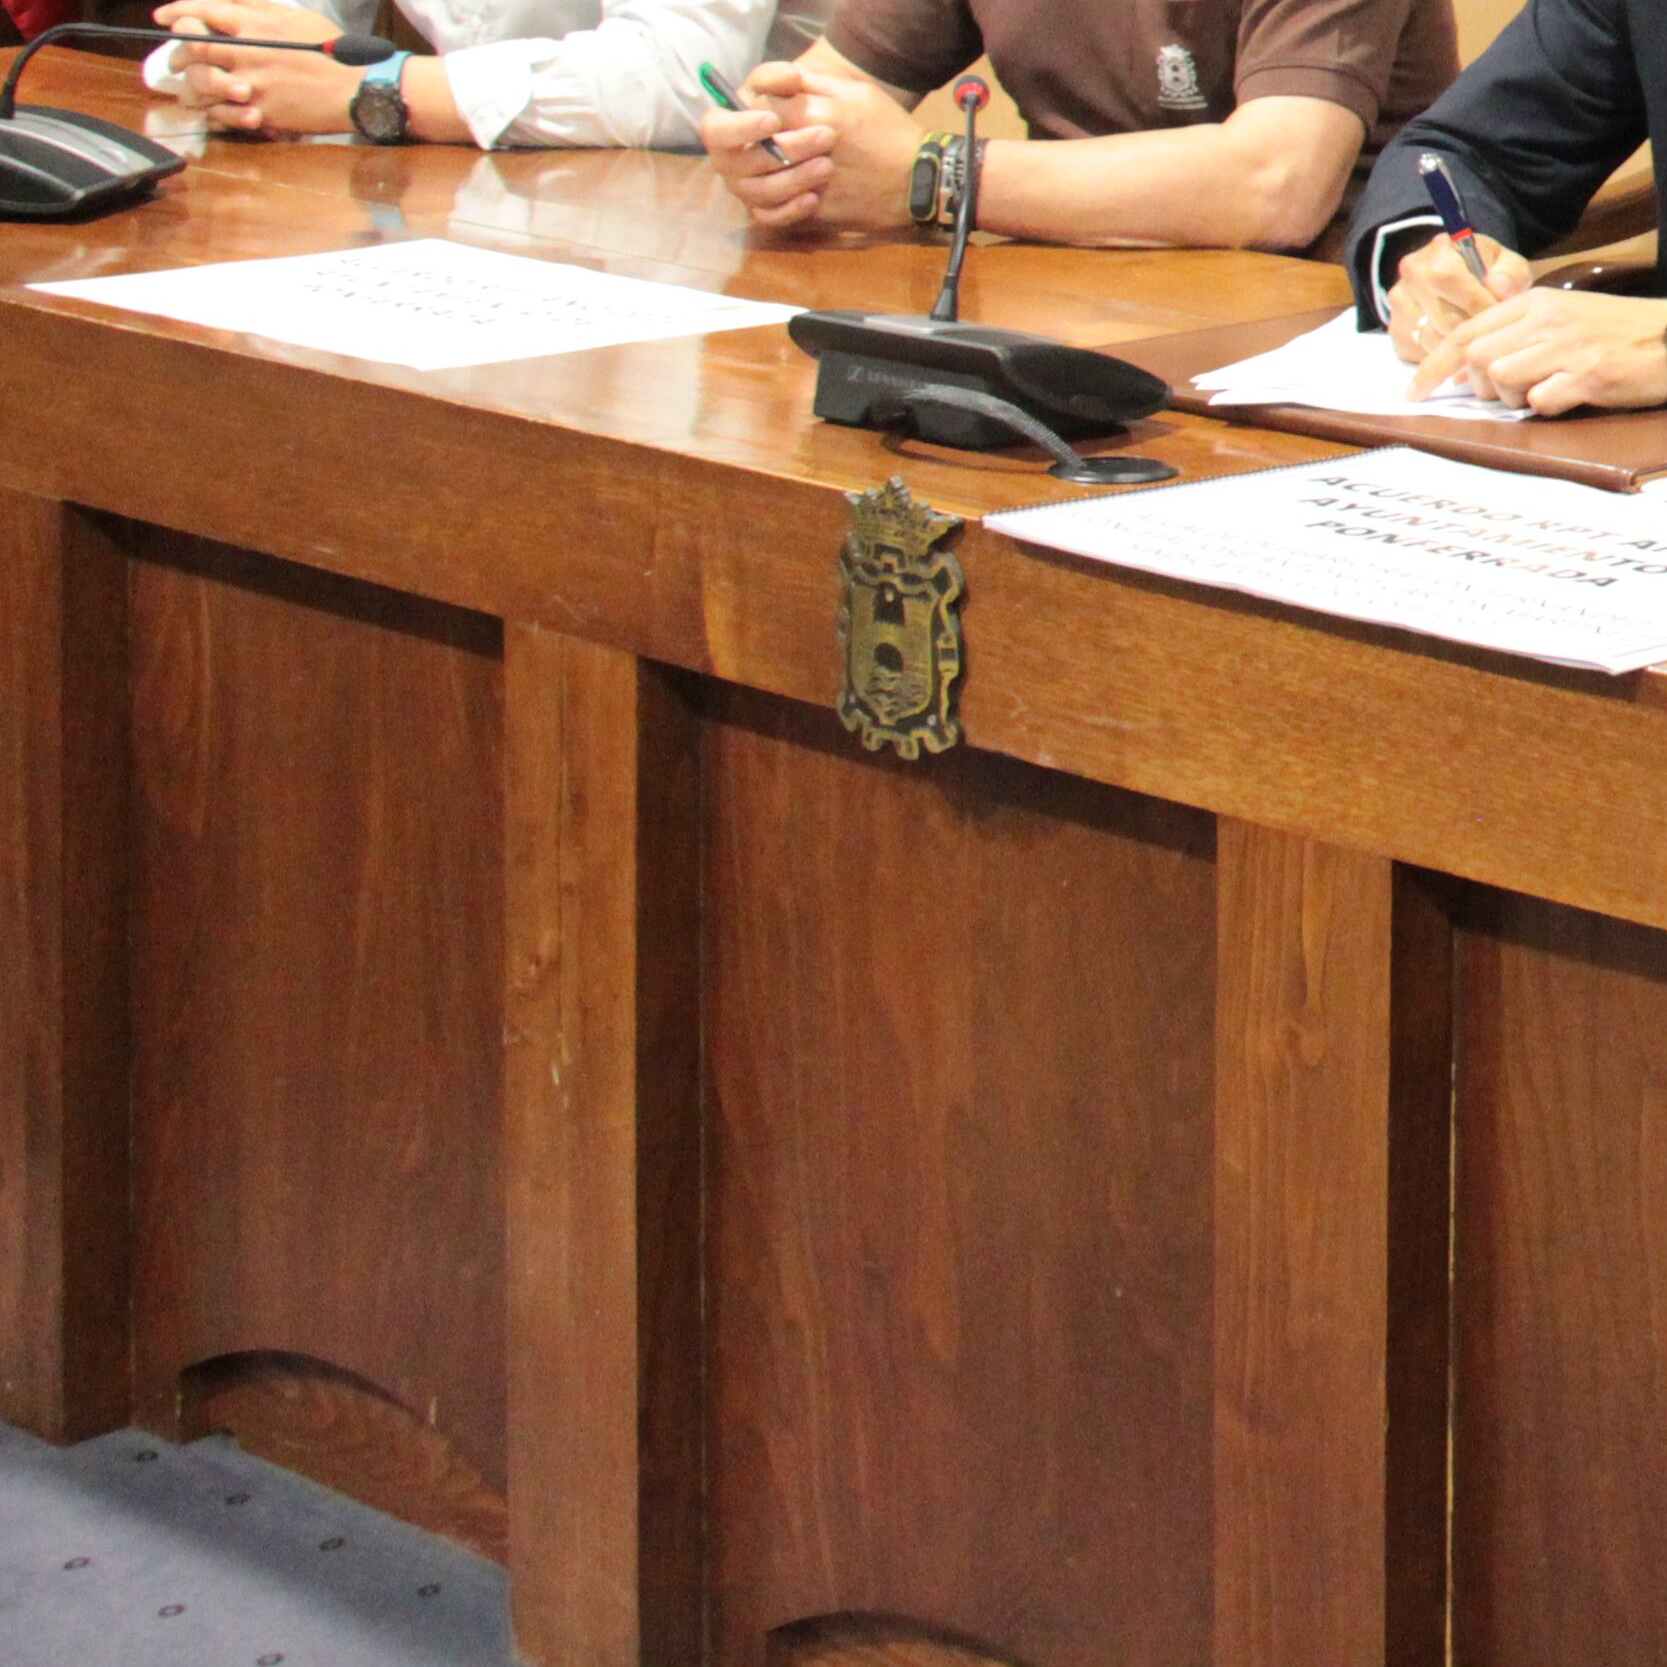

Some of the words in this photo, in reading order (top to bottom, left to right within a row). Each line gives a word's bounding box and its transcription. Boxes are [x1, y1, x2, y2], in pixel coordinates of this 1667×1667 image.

[1309, 476, 1523, 522] ACUERDO
[1526, 519, 1623, 541] RPT
[1303, 519, 1620, 588] PONFERRADA
